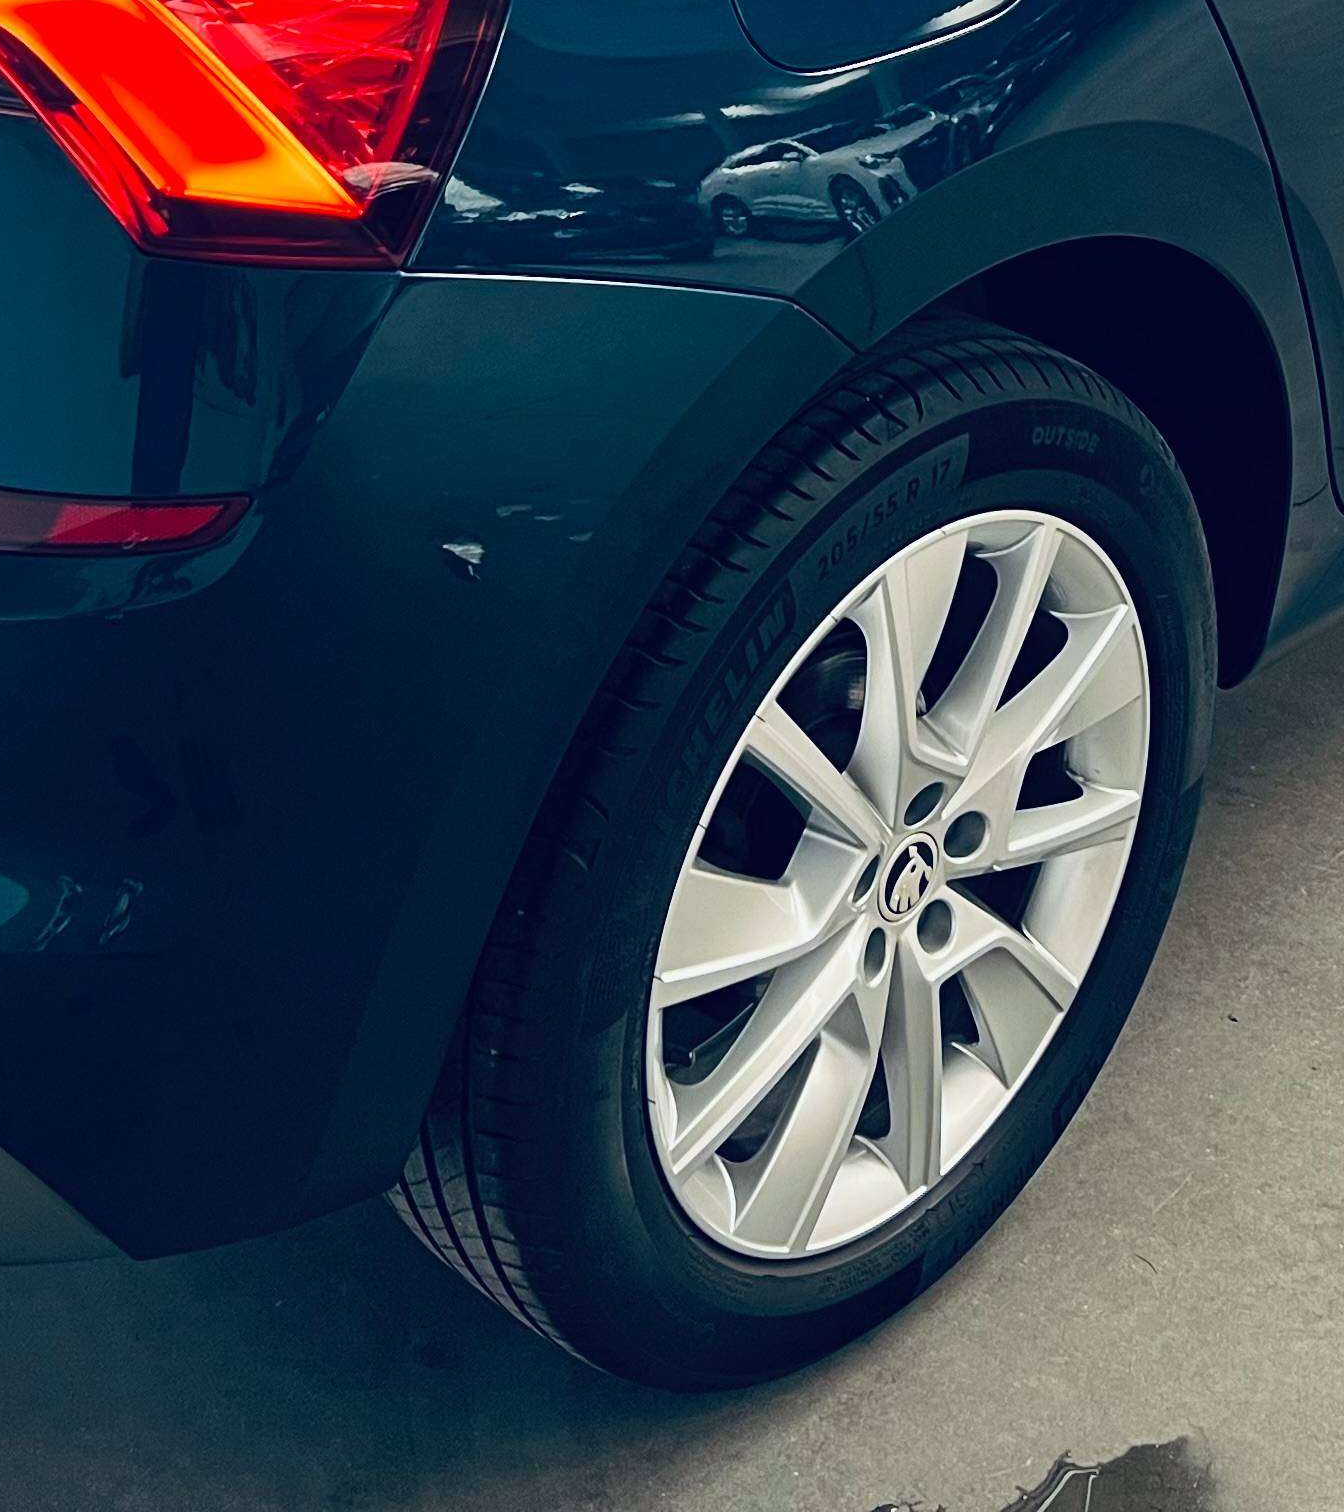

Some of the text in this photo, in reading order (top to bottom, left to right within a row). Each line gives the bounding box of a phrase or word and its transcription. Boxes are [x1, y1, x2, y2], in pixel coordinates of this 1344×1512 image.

[1031, 425, 1101, 456] OUTSIDE
[817, 492, 896, 582] 205/55
[906, 478, 920, 506] R
[930, 457, 953, 489] 17
